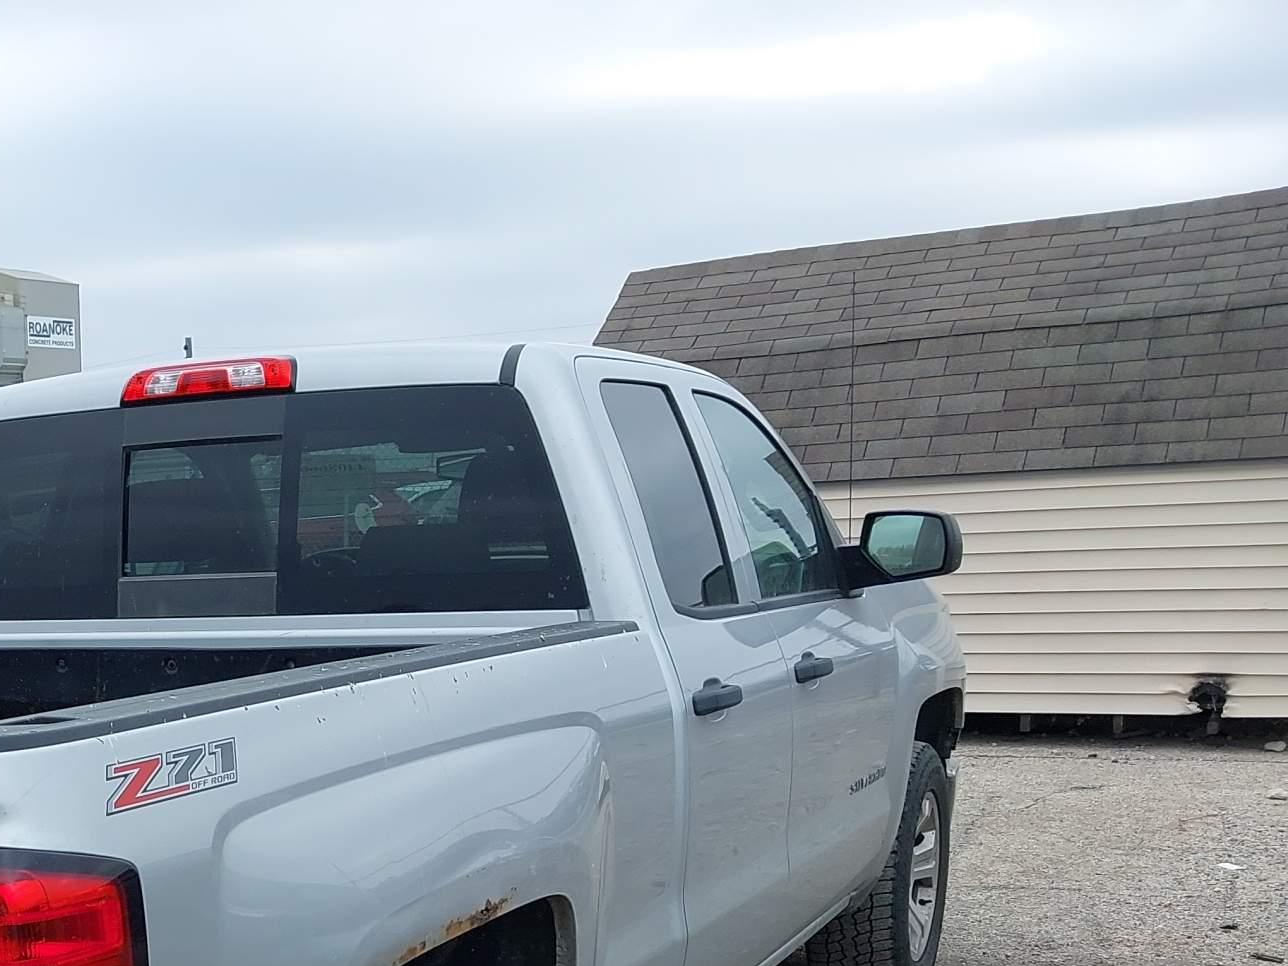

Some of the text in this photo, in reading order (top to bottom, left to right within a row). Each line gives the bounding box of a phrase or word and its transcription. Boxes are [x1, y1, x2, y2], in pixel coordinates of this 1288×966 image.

[28, 320, 73, 336] ROANOKE
[106, 737, 238, 816] Z71
[191, 772, 235, 790] OFF ROAD
